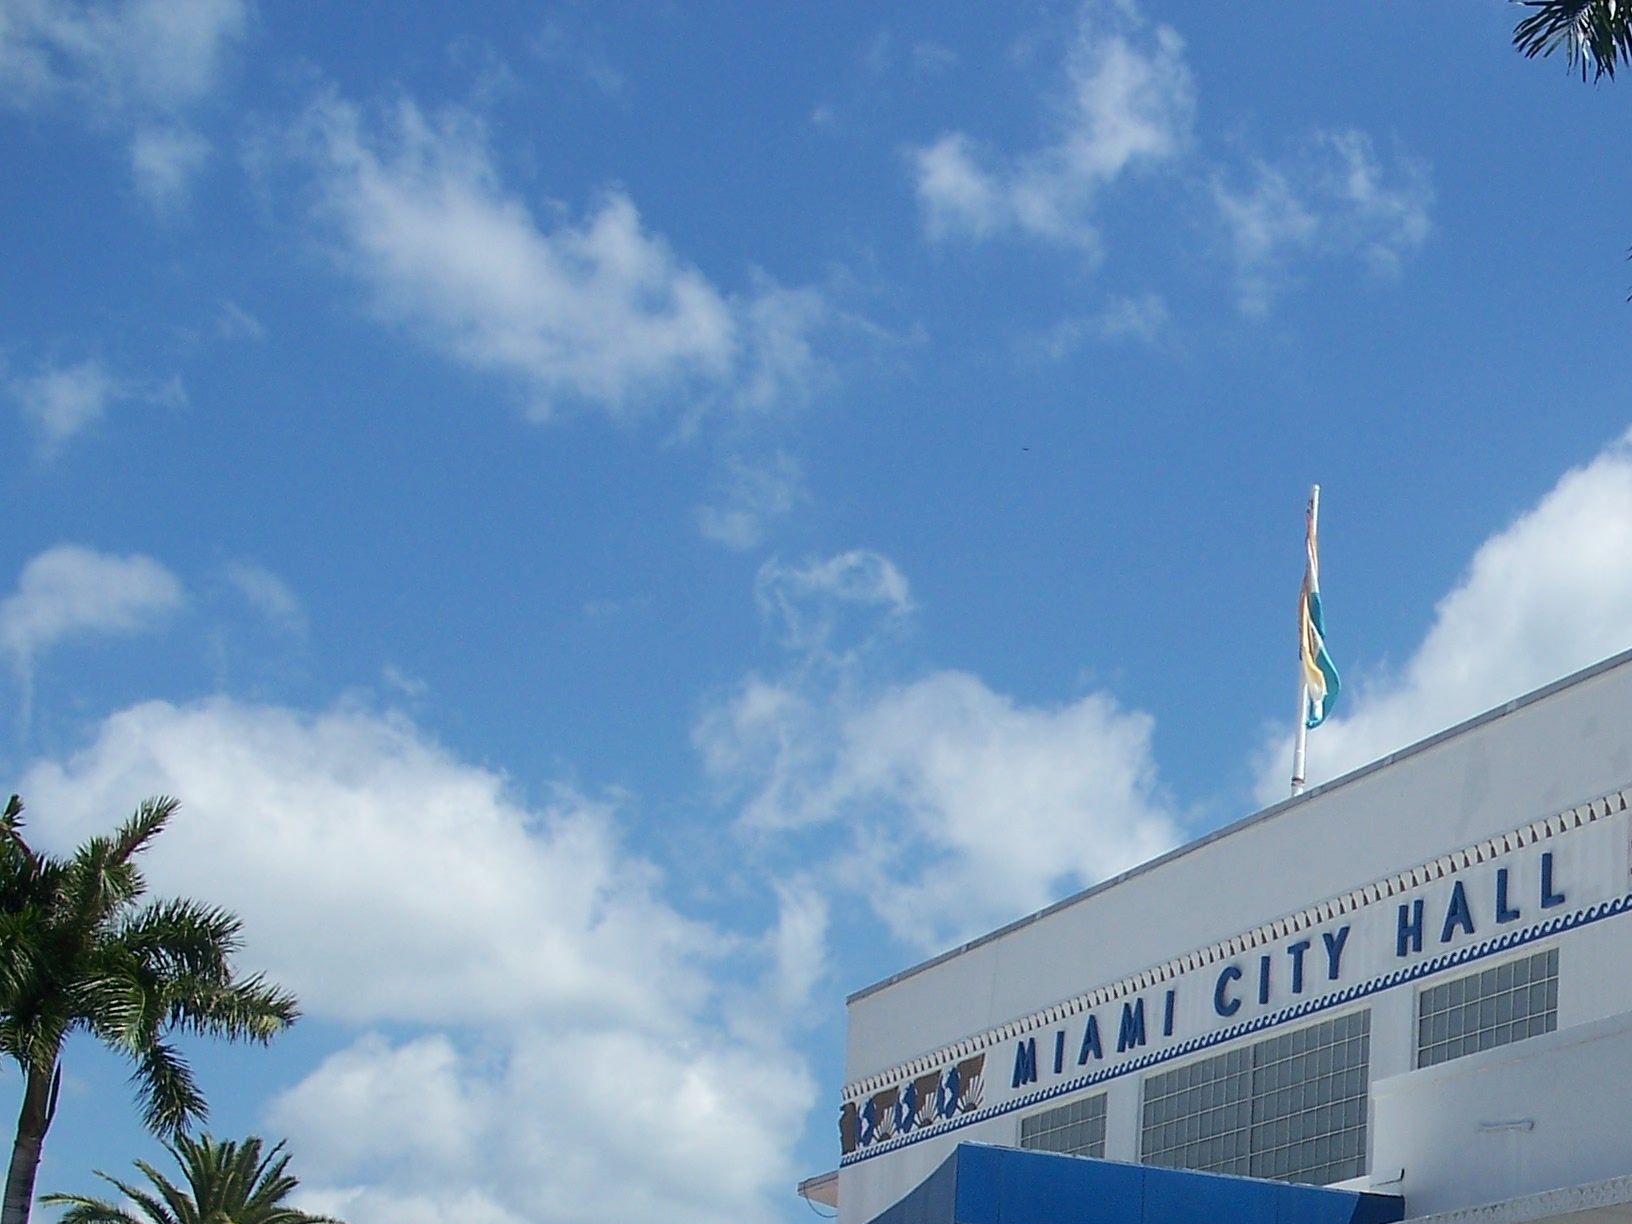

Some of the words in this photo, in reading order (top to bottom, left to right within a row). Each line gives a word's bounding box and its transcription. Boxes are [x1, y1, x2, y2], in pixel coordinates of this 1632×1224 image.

[1011, 990, 1175, 1088] MIAMI
[1214, 926, 1351, 1018] CITY
[1396, 852, 1567, 957] HALL
